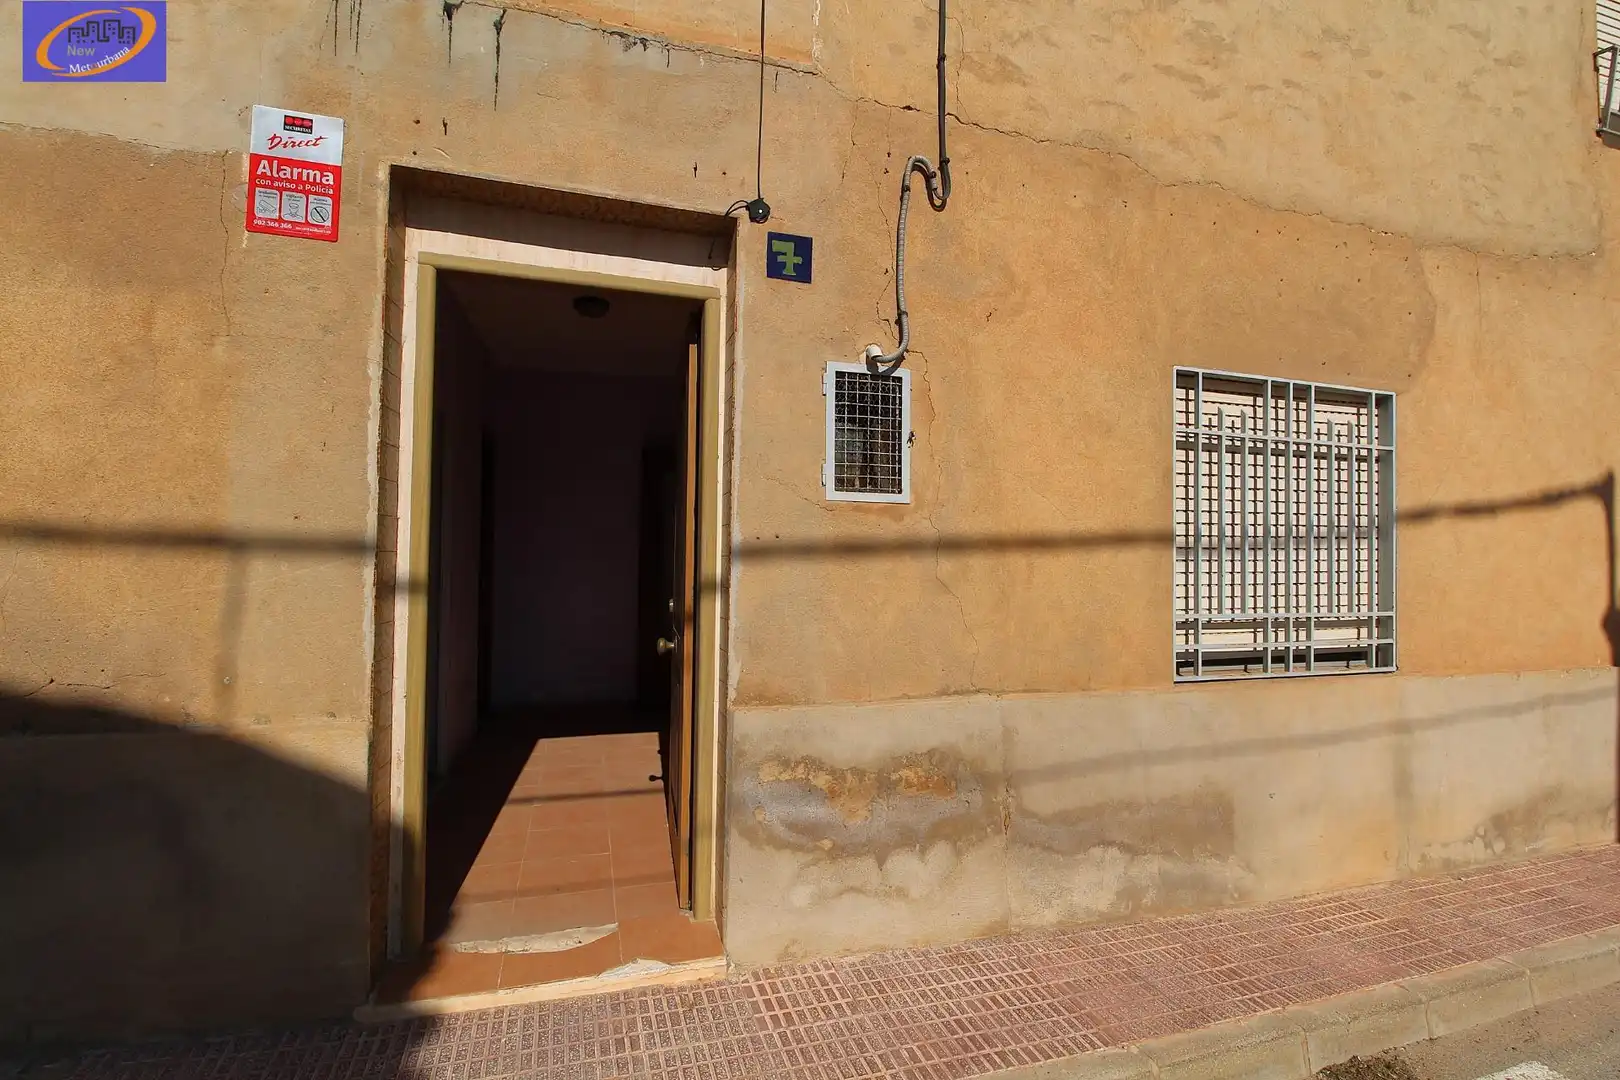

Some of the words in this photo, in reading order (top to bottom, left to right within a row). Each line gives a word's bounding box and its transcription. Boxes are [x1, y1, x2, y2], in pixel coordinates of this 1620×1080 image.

[268, 134, 327, 150] Direct
[257, 160, 334, 184] Alarma
[273, 180, 296, 189] aviso
[771, 240, 803, 275] 7
